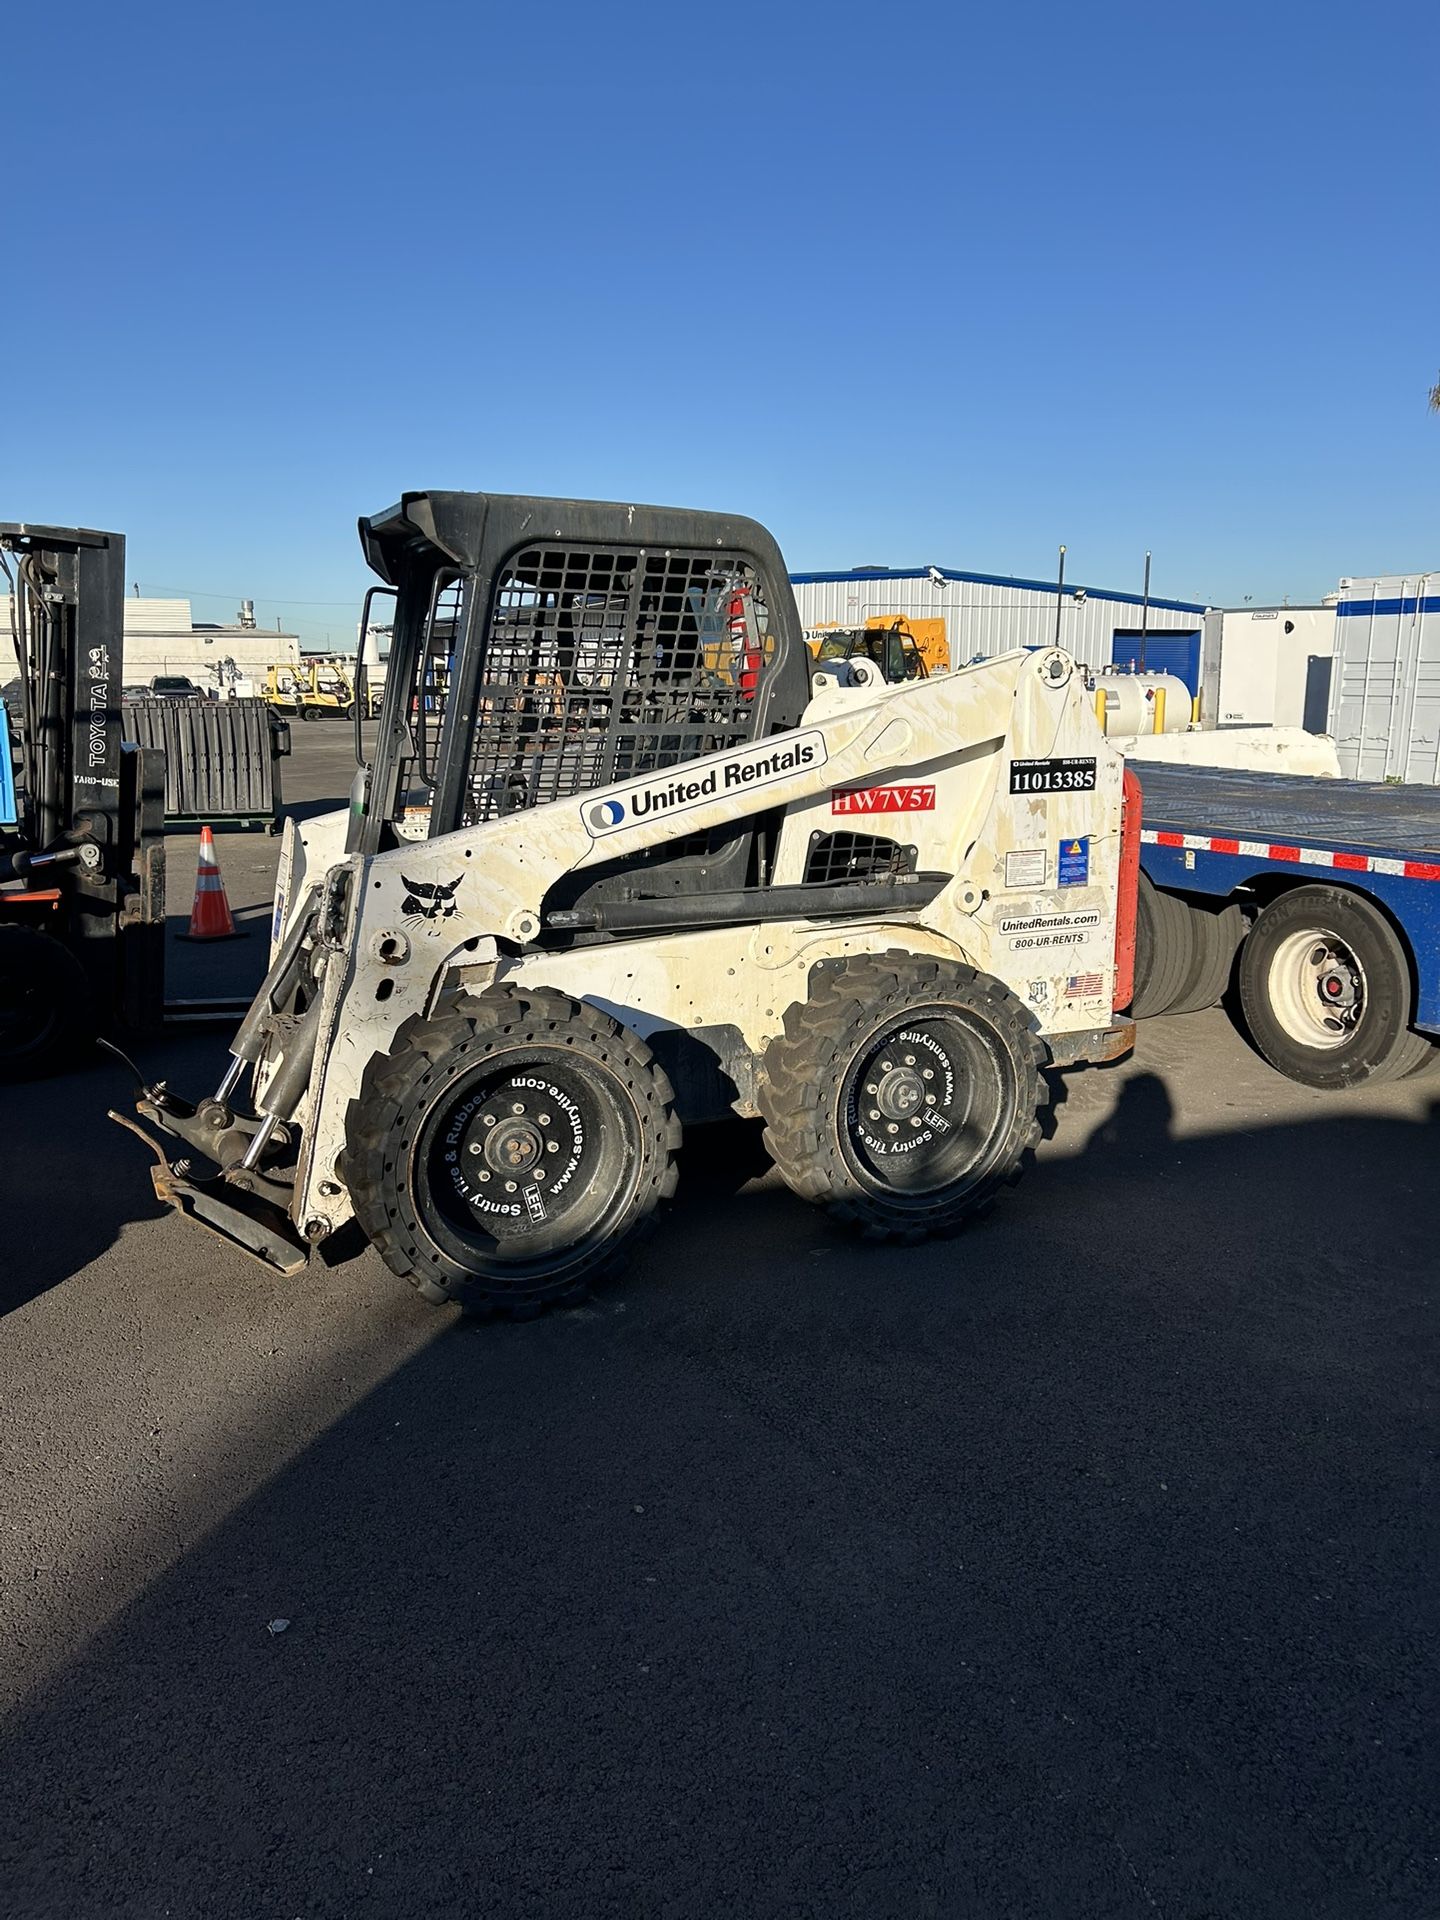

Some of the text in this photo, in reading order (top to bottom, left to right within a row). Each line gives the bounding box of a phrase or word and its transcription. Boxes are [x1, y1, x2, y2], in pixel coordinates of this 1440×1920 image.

[89, 684, 108, 767] TOYOTA
[73, 775, 119, 788] YARD-USE
[631, 743, 815, 817] United Rentals
[1012, 770, 1095, 791] 11013385
[833, 787, 935, 813] HW7V57
[1001, 914, 1098, 932] UnitedRentals.com
[923, 1110, 951, 1134] LEFT
[511, 1077, 583, 1196] www.sentrytire.com
[864, 1134, 888, 1155] Tire
[890, 1129, 933, 1153] Sentry
[444, 1089, 522, 1217] Sentry Tire & Rubber
[524, 1185, 546, 1220] LEFT
